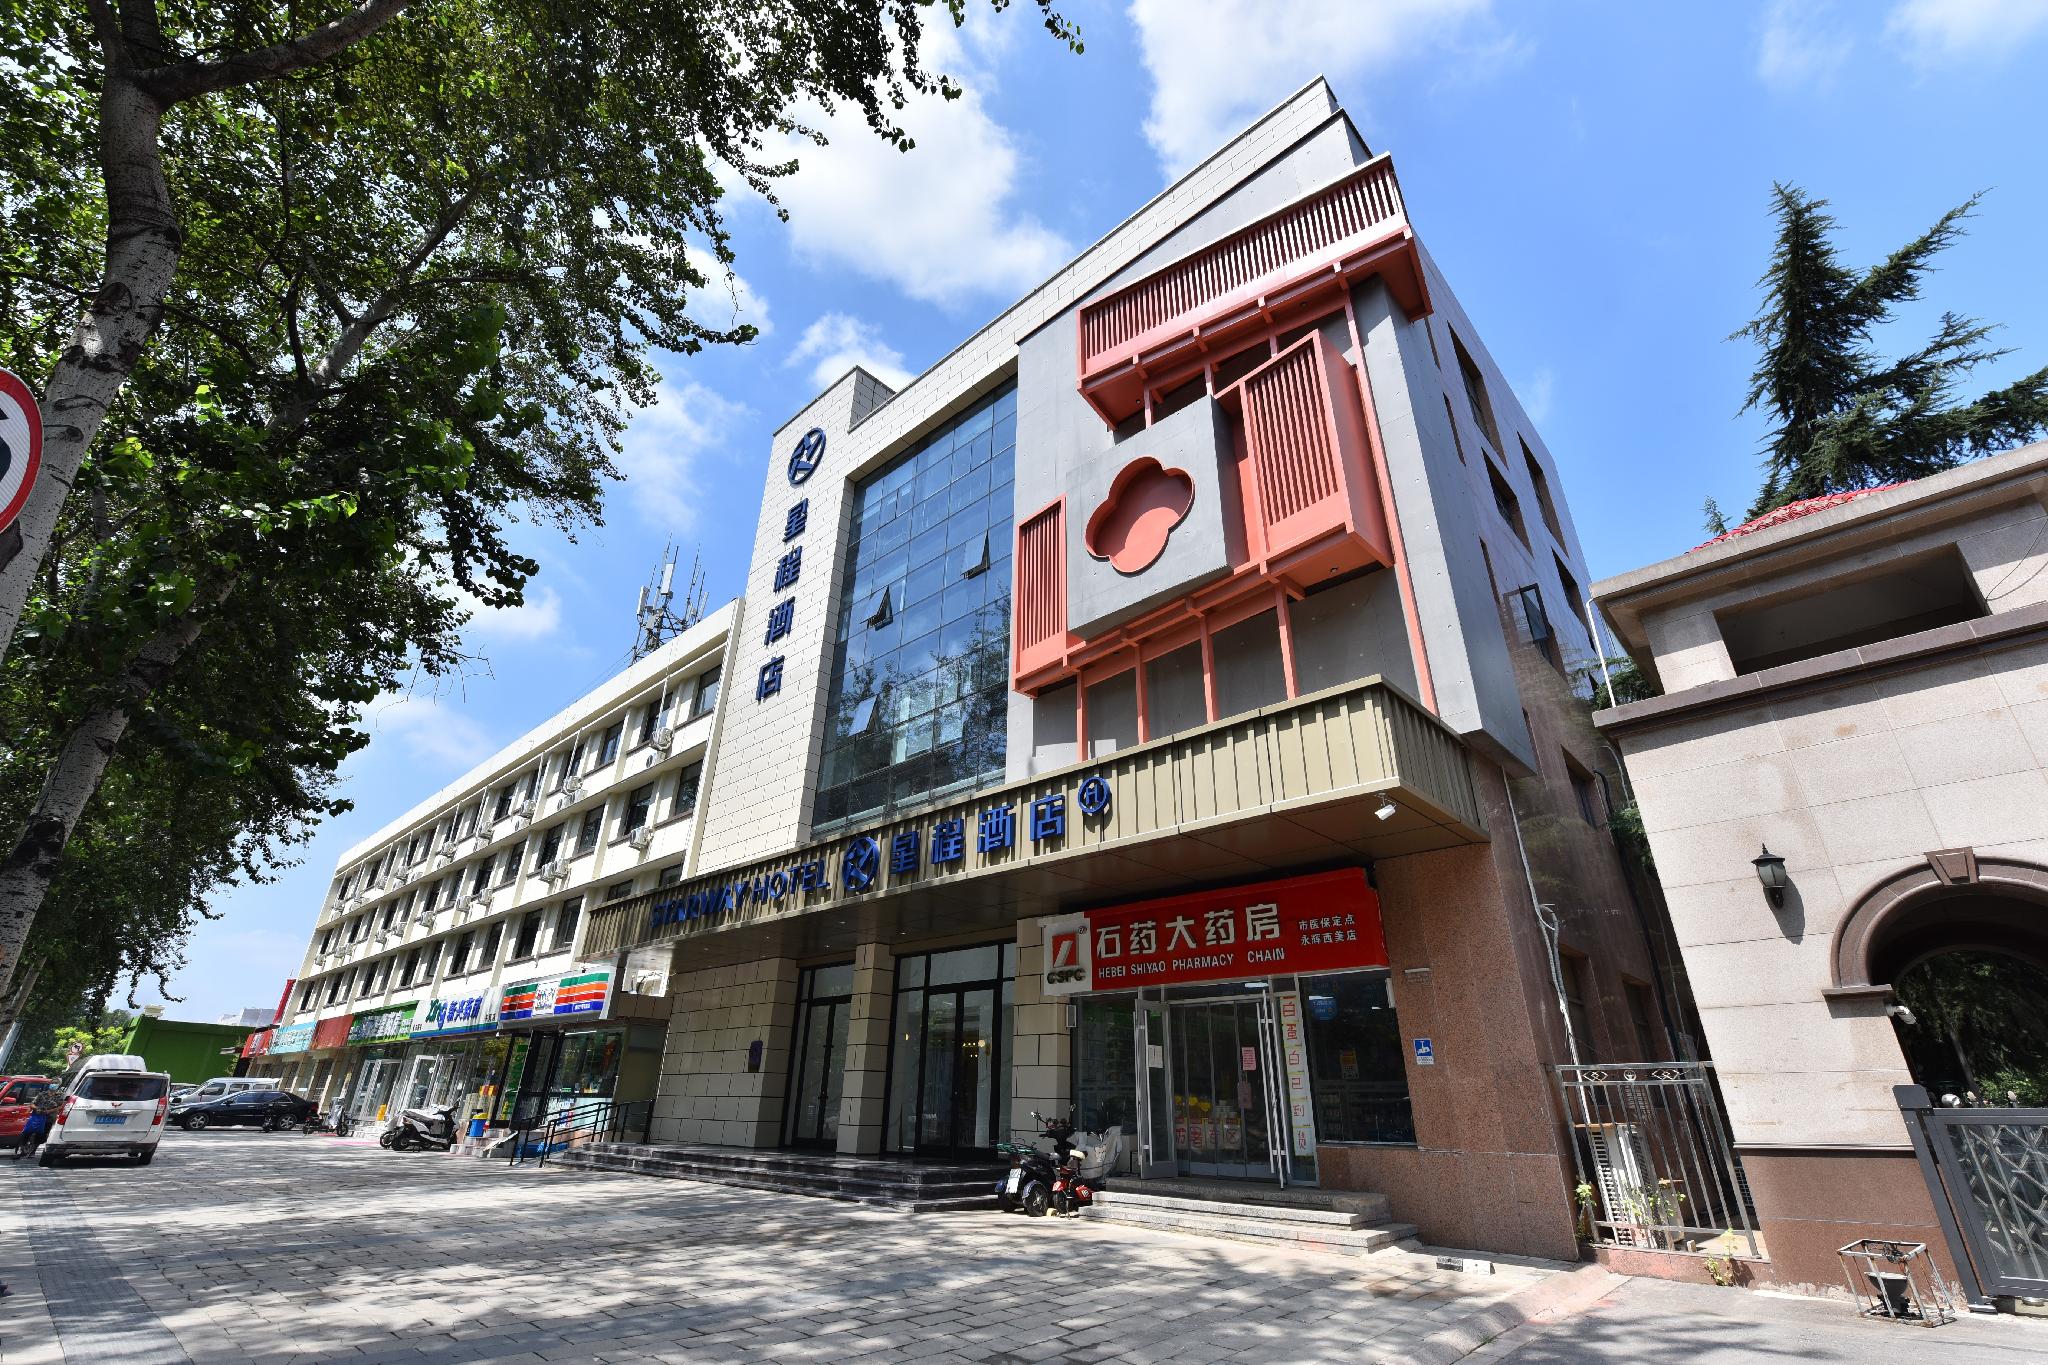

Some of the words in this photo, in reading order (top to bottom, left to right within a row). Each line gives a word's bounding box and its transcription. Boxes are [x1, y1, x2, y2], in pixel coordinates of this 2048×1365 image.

[755, 498, 808, 702] 星程酒店
[891, 794, 1066, 874] 星程酒店
[752, 859, 831, 905] HOTEL
[1096, 903, 1281, 959] 石药大药房
[1299, 914, 1355, 931] 市医保定点
[1046, 968, 1087, 985] CSPC
[1098, 965, 1127, 978] HEBEI
[1130, 960, 1166, 975] SHIYAO
[1172, 953, 1235, 971] PHARMACY
[1247, 947, 1286, 963] CHAIN
